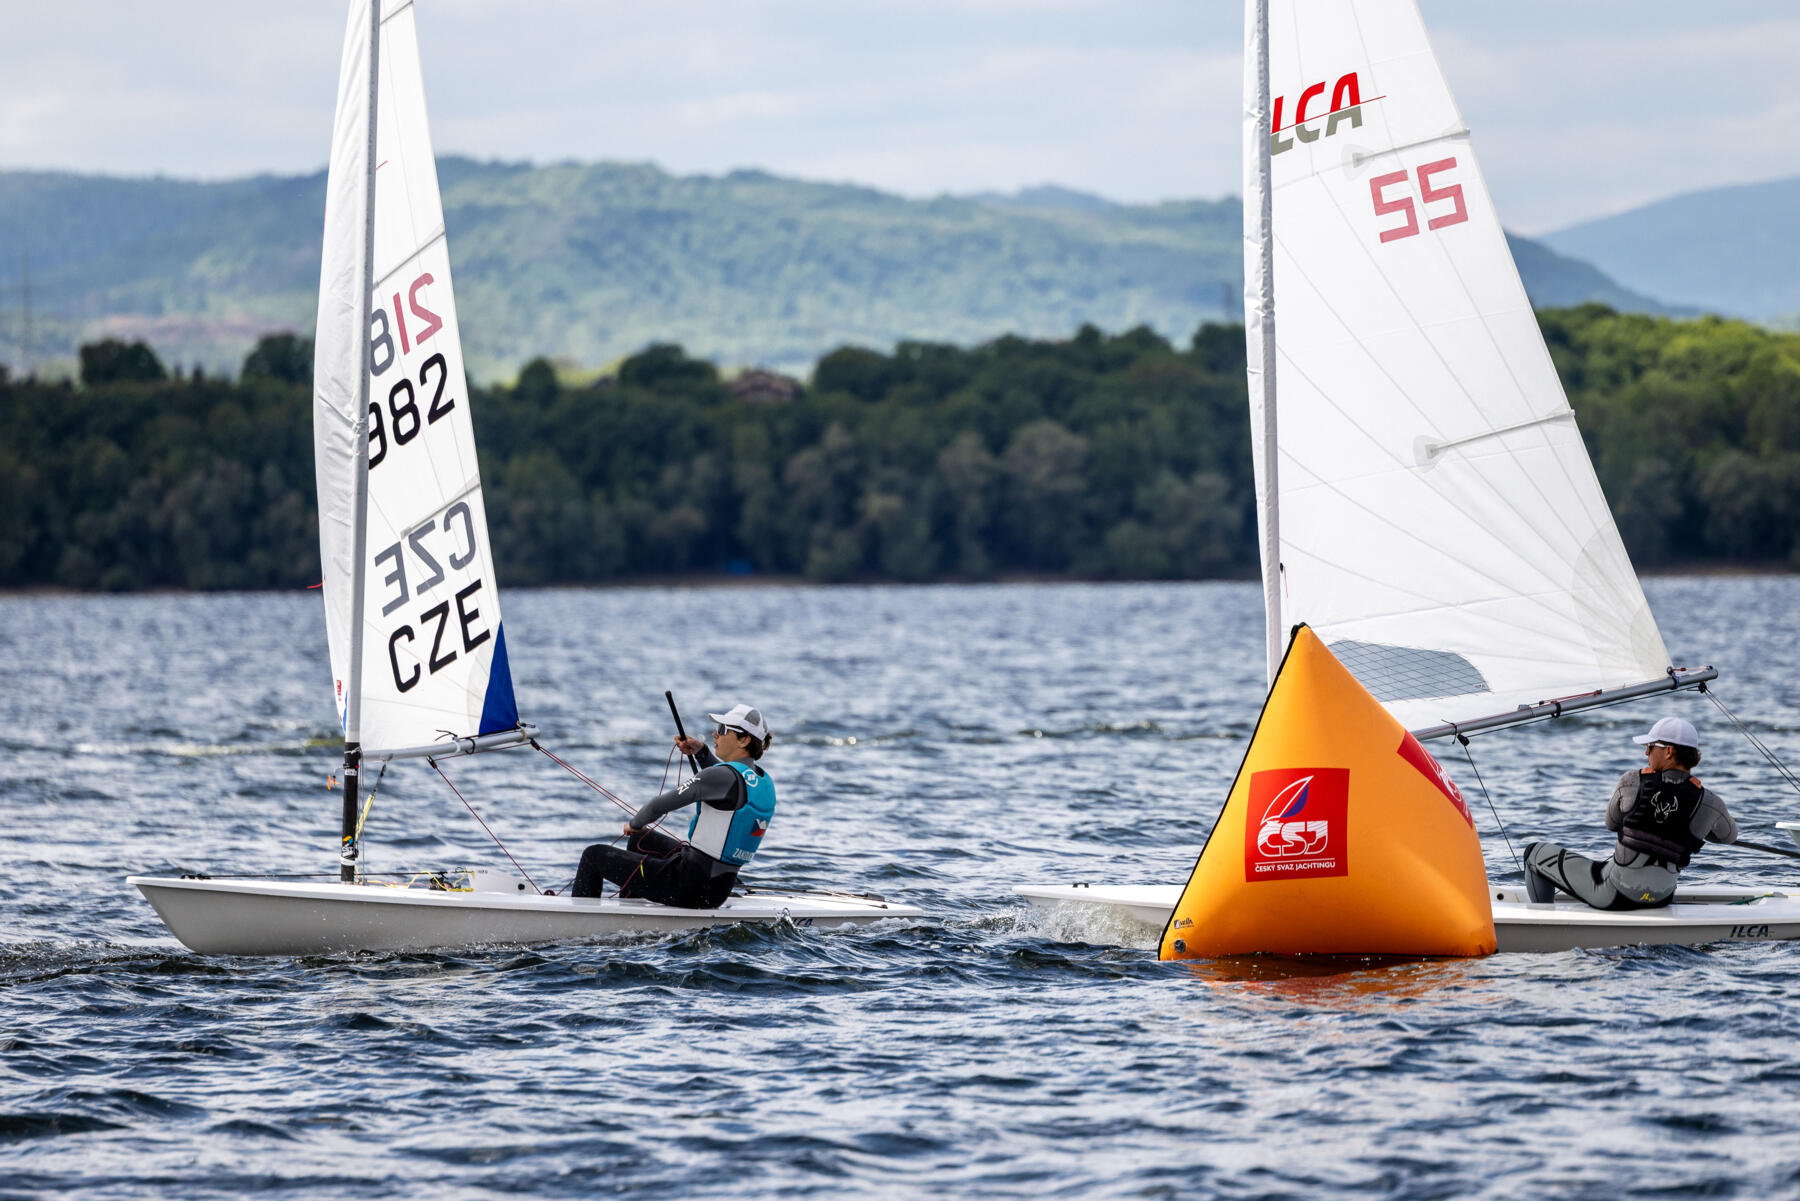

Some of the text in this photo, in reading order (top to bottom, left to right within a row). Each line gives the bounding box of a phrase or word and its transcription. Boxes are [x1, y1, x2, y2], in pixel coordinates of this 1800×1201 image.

[1271, 72, 1363, 156] LCA
[388, 578, 491, 694] CZE
[1276, 863, 1295, 871] SVAZ
[1295, 861, 1336, 872] JACHTINGU
[1729, 925, 1769, 938] ILCA
